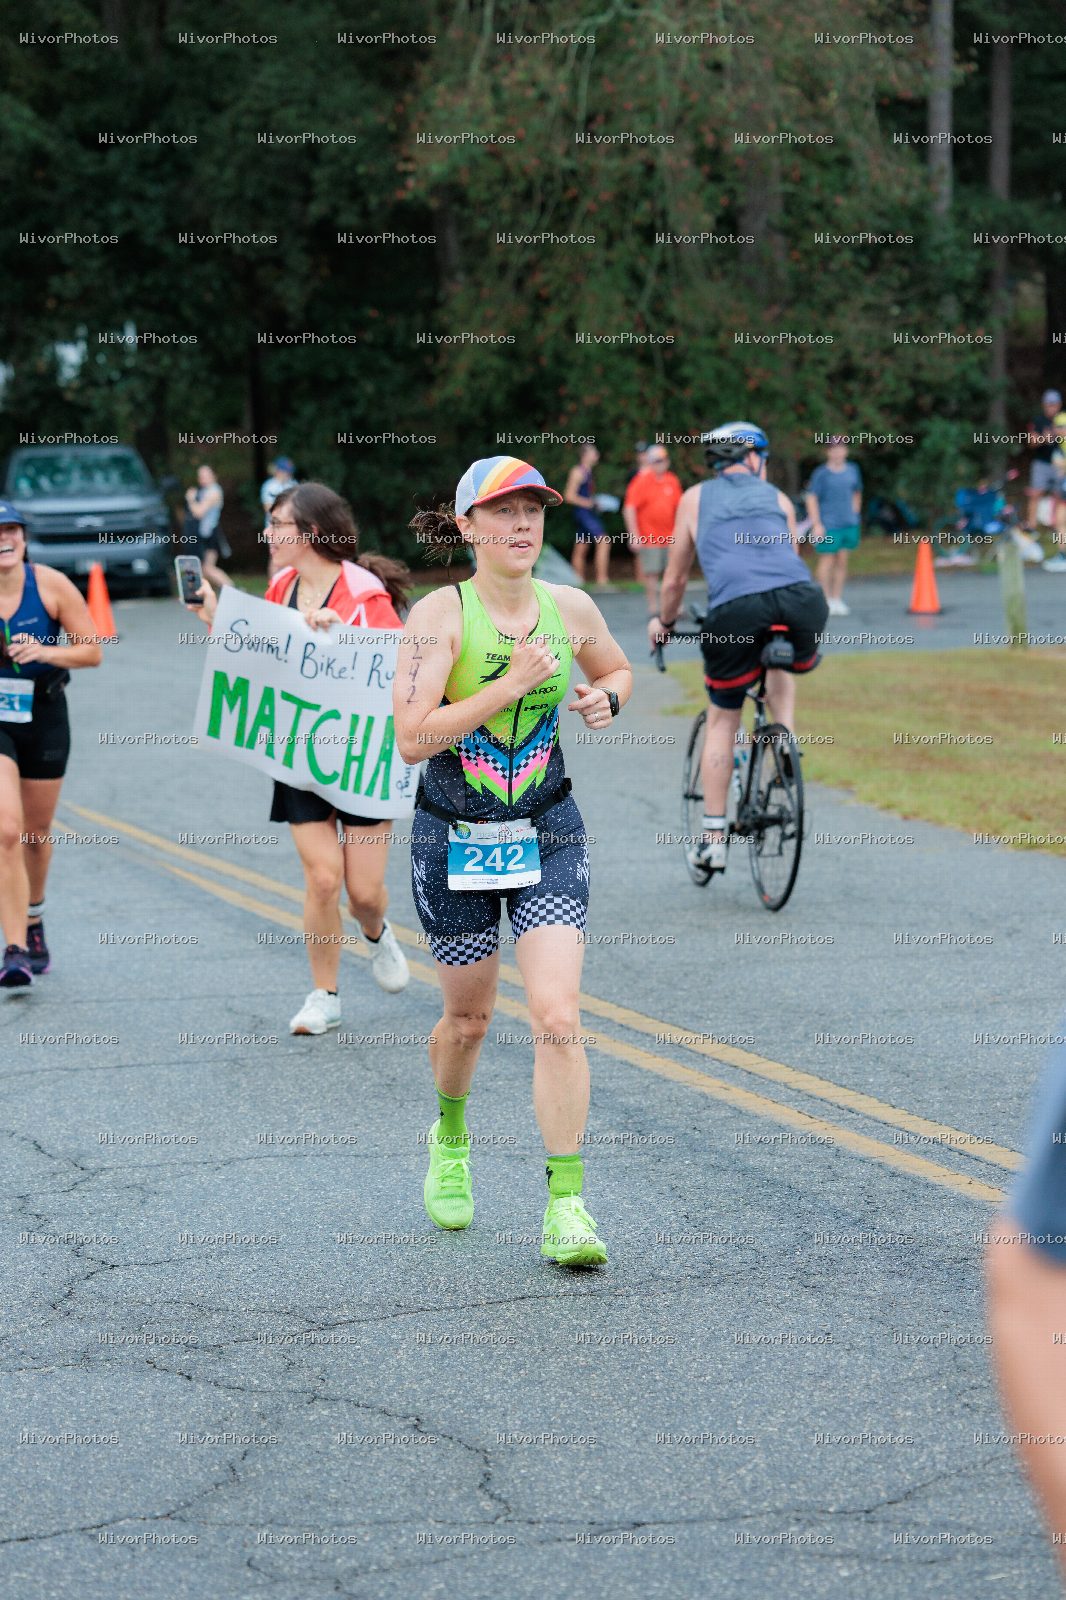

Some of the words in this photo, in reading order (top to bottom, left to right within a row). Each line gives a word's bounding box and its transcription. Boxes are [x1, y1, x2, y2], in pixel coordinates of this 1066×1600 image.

[223, 618, 292, 664] Swim!
[299, 642, 358, 681] Bike!
[366, 653, 395, 690] Ru
[486, 652, 511, 661] TEAM
[206, 670, 395, 801] MATCHA
[463, 844, 526, 872] 242
